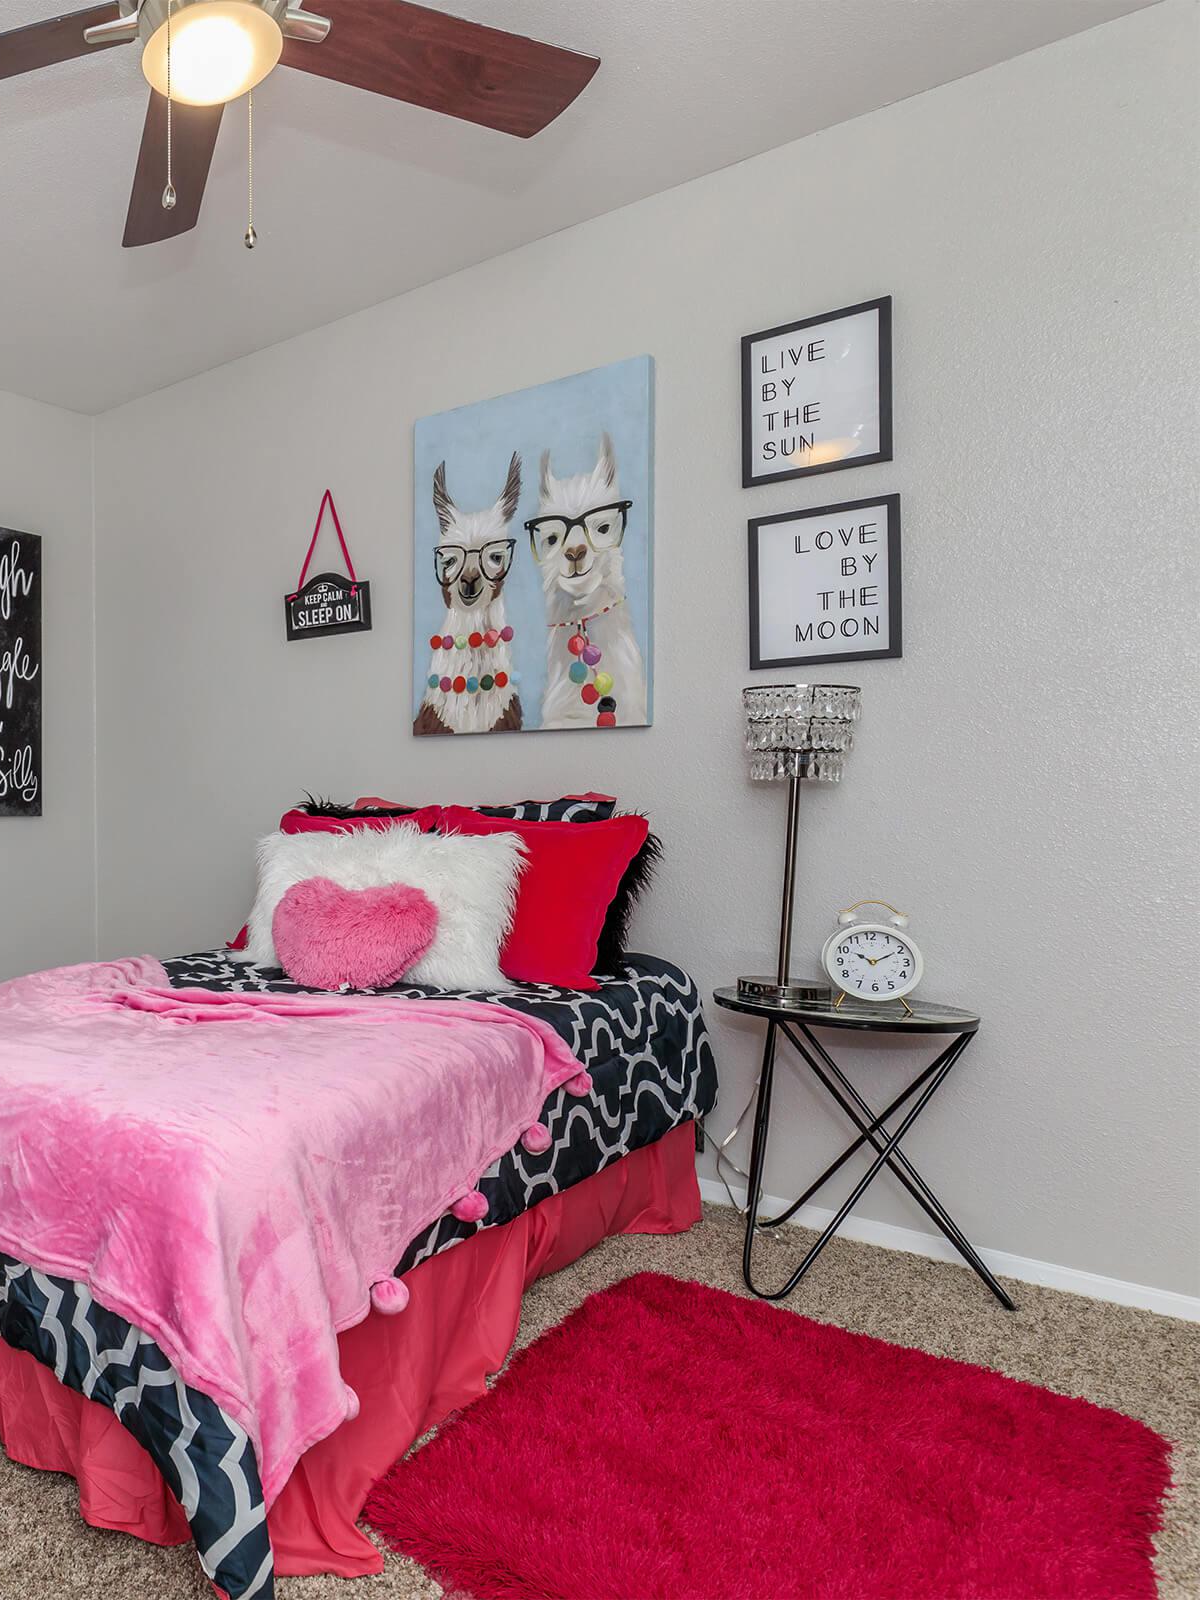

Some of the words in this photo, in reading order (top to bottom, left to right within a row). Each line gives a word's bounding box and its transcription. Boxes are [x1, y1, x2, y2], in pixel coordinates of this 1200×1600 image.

[761, 340, 825, 374] LIVE
[762, 377, 796, 402] BY
[762, 402, 821, 432] THE
[762, 432, 815, 460] SUN
[794, 523, 878, 554] LOVE
[841, 553, 878, 577] BY
[304, 593, 322, 606] KEEP
[323, 590, 343, 602] CALM
[817, 586, 878, 611] THE
[298, 607, 333, 627] SLEEP
[335, 604, 352, 621] ON
[795, 615, 879, 642] MOON
[848, 936, 860, 944] 11
[864, 932, 876, 941] 12
[885, 936, 890, 944] 1
[837, 945, 850, 954] 10
[897, 945, 904, 954] 2
[836, 957, 844, 966] 9
[903, 958, 910, 967] 3
[842, 969, 849, 978] 8
[899, 970, 907, 979] 4
[855, 980, 863, 989] 7
[872, 983, 879, 992] 6
[888, 981, 895, 990] 5
